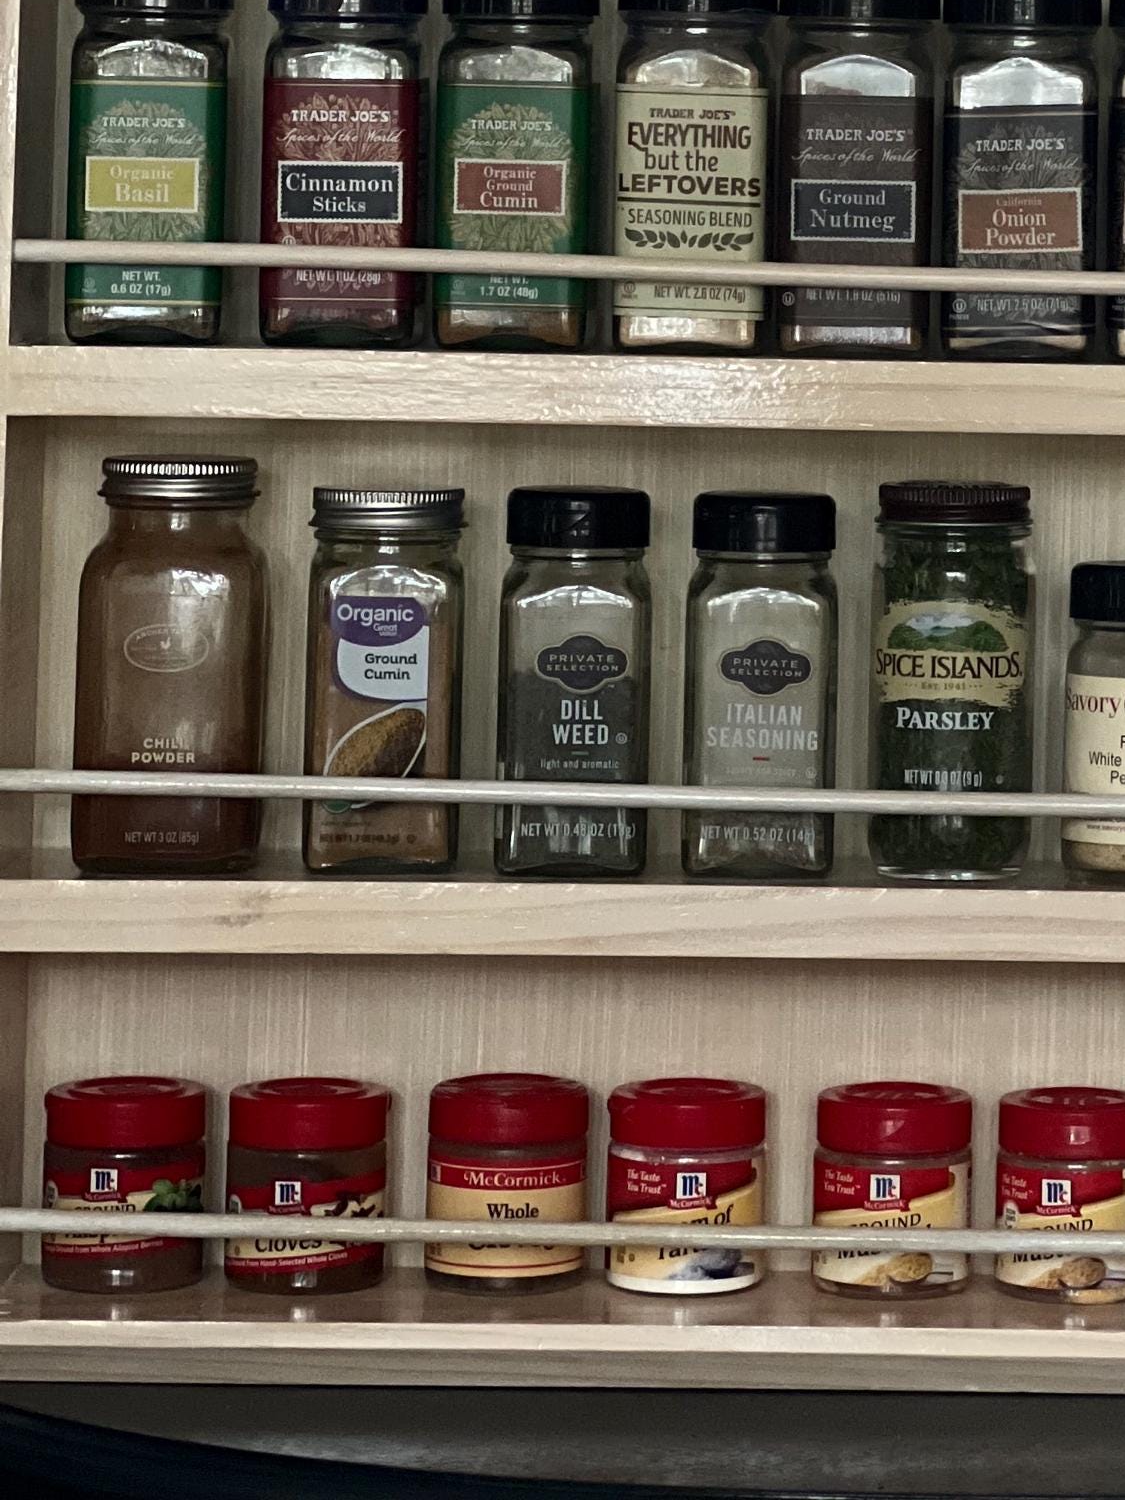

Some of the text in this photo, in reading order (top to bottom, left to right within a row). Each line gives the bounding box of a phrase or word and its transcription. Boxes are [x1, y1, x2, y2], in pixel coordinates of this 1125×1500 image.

[649, 108, 732, 120] TRADER JOE'S
[628, 122, 752, 151] EVERYTHING
[806, 128, 906, 142] TRADER JOE'S
[644, 147, 719, 172] but the
[110, 165, 175, 181] Organic
[483, 167, 537, 180] Organic
[286, 173, 394, 193] Cinnamon
[486, 180, 533, 192] Ground
[618, 173, 761, 197] LEFTOVERS
[115, 183, 170, 203] Basil
[480, 191, 538, 209] Cumin
[819, 189, 886, 206] Ground
[312, 196, 367, 213] Sticks
[628, 208, 753, 228] SEASONING BLEND
[810, 209, 897, 232] Nutmeg
[991, 209, 1047, 227] Onion
[985, 226, 1056, 246] Powder
[338, 603, 415, 626] Organic
[365, 653, 417, 665] Ground
[549, 653, 616, 663] PRIVATE
[876, 649, 925, 679] SPICE
[365, 669, 411, 681] Cumin
[546, 663, 619, 673] SELECTION
[560, 700, 604, 721] DILL
[1065, 688, 1122, 719] Savory
[726, 703, 803, 727] ITALIAN
[896, 707, 995, 731] PARSLEY
[552, 724, 610, 746] WEED
[707, 726, 818, 751] SEASONING
[143, 738, 188, 751] CHILI
[131, 752, 195, 764] POWDER
[1088, 751, 1122, 767] White
[463, 1170, 562, 1187] McCormick
[487, 1202, 540, 1220] Whole
[669, 1197, 712, 1208] McCormick
